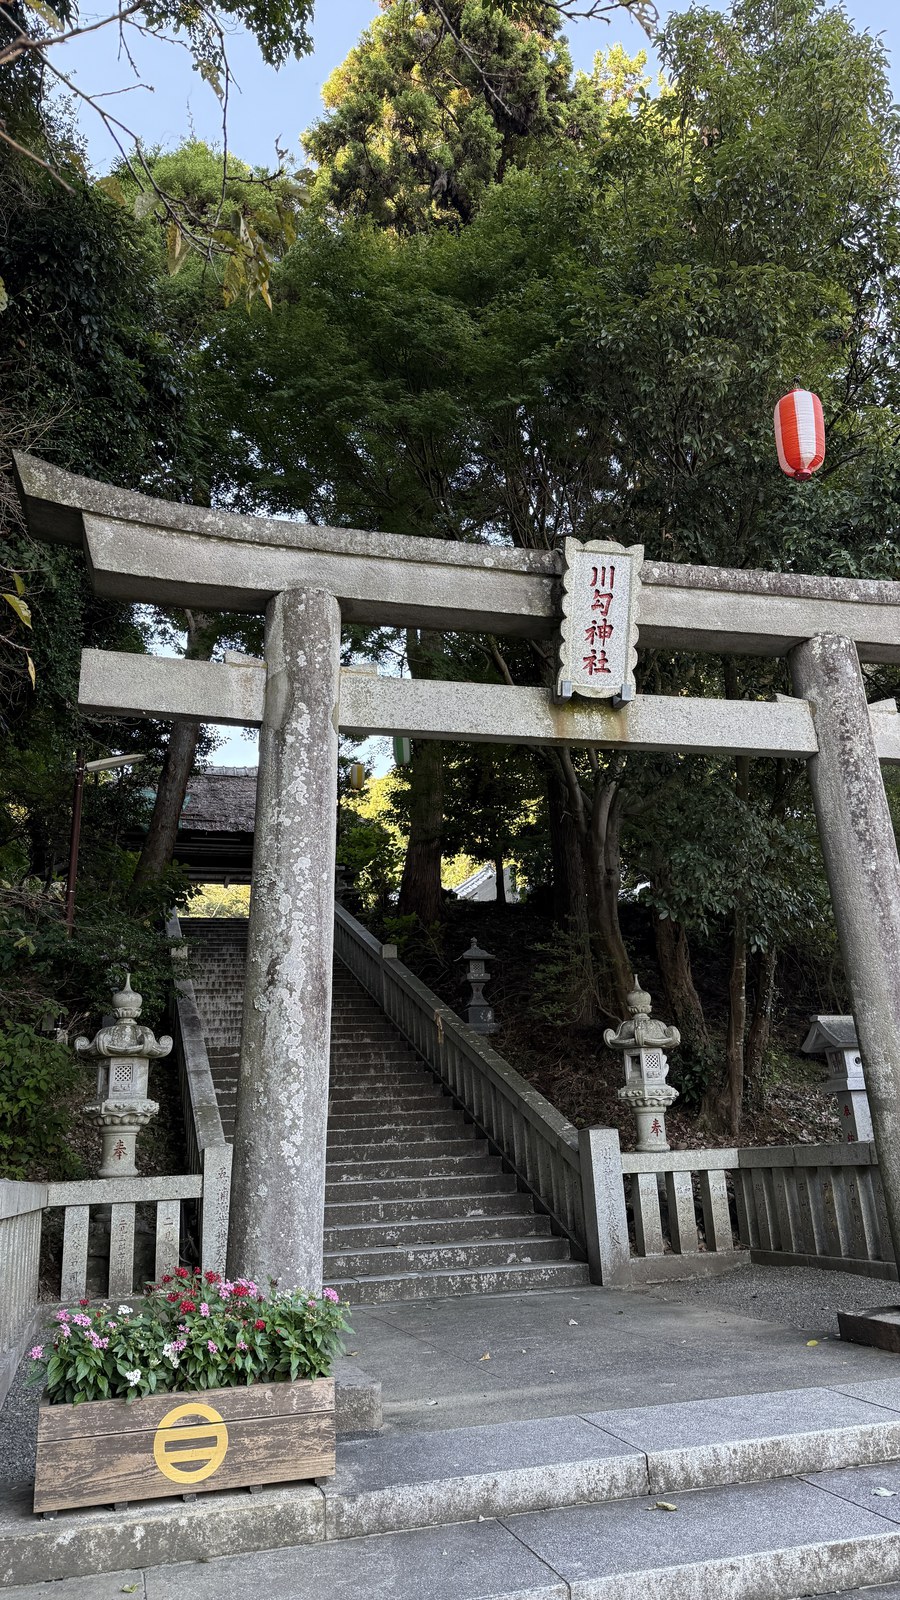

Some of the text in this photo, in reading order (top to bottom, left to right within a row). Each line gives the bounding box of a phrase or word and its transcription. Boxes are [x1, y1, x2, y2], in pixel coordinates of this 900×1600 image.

[582, 565, 615, 676] 川勾神社
[650, 1118, 663, 1137] 奉
[113, 1139, 128, 1160] 奉
